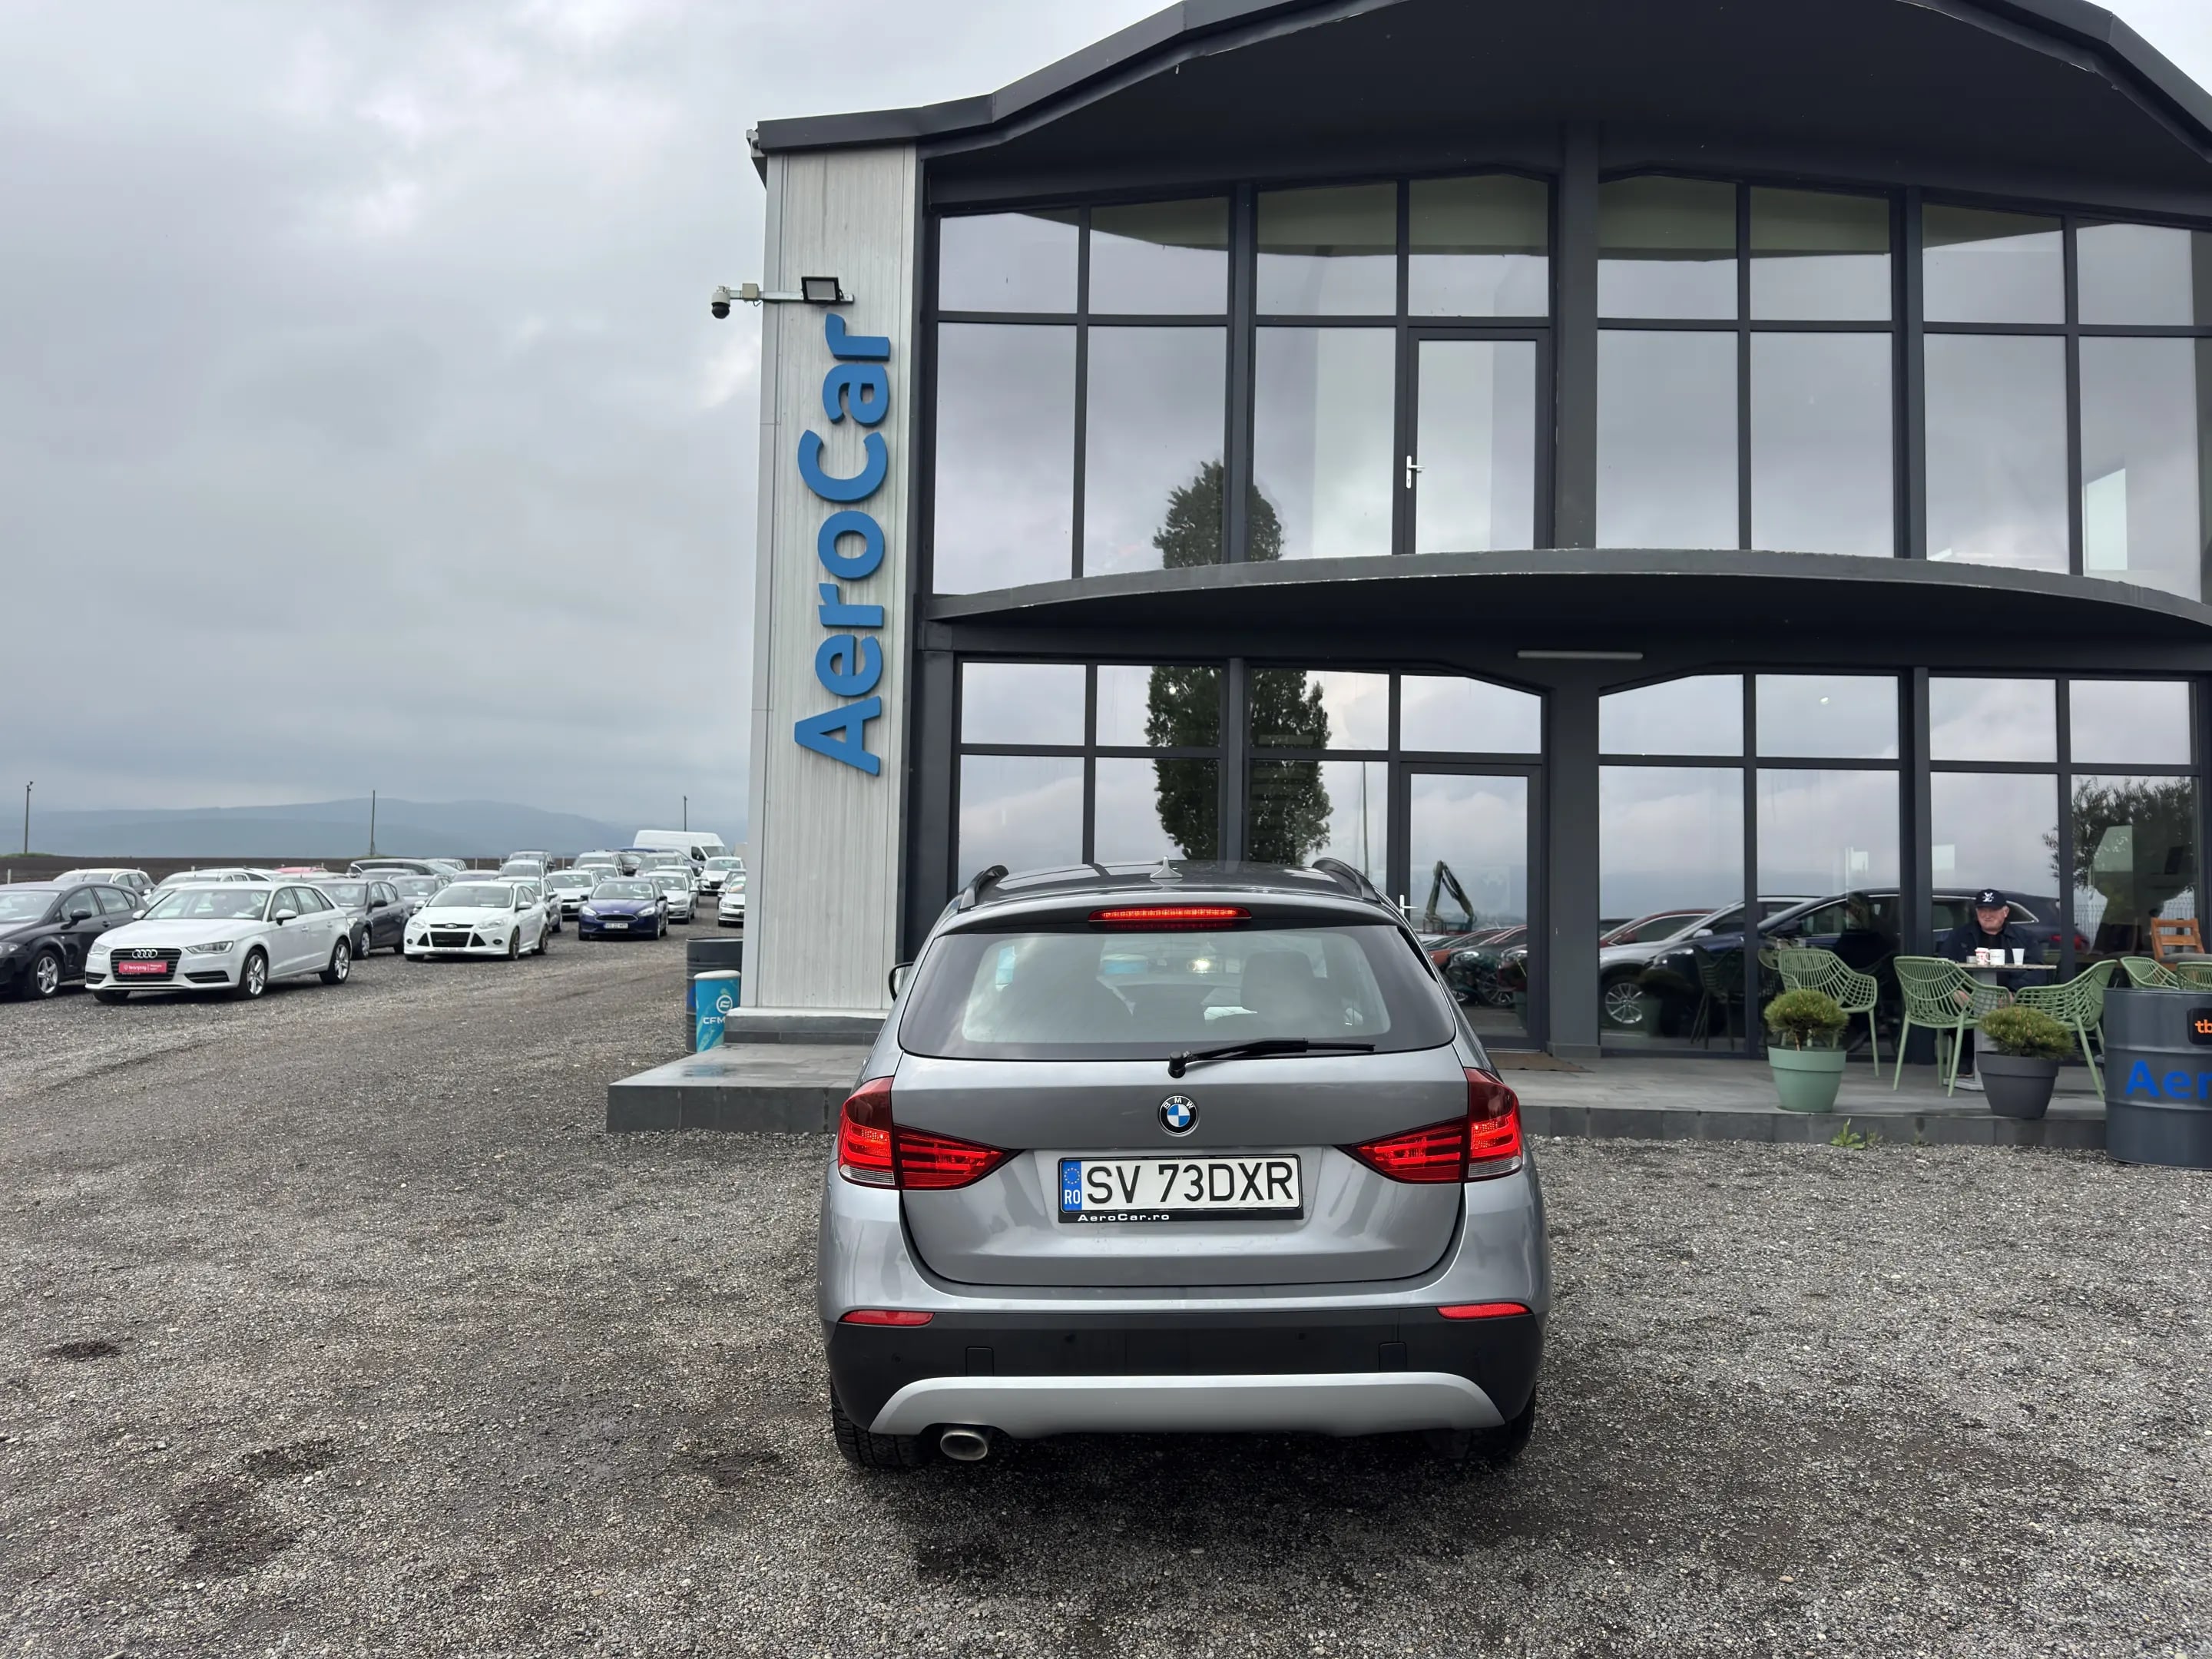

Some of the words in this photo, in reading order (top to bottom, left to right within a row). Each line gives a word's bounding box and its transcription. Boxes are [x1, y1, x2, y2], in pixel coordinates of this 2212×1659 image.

[794, 313, 890, 777] AeroCar
[1163, 1097, 1194, 1110] BMW
[1087, 1165, 1141, 1204] SV
[1158, 1162, 1294, 1203] 73DXR
[1065, 1189, 1081, 1204] RO
[1078, 1213, 1170, 1223] AeroCar.ro
